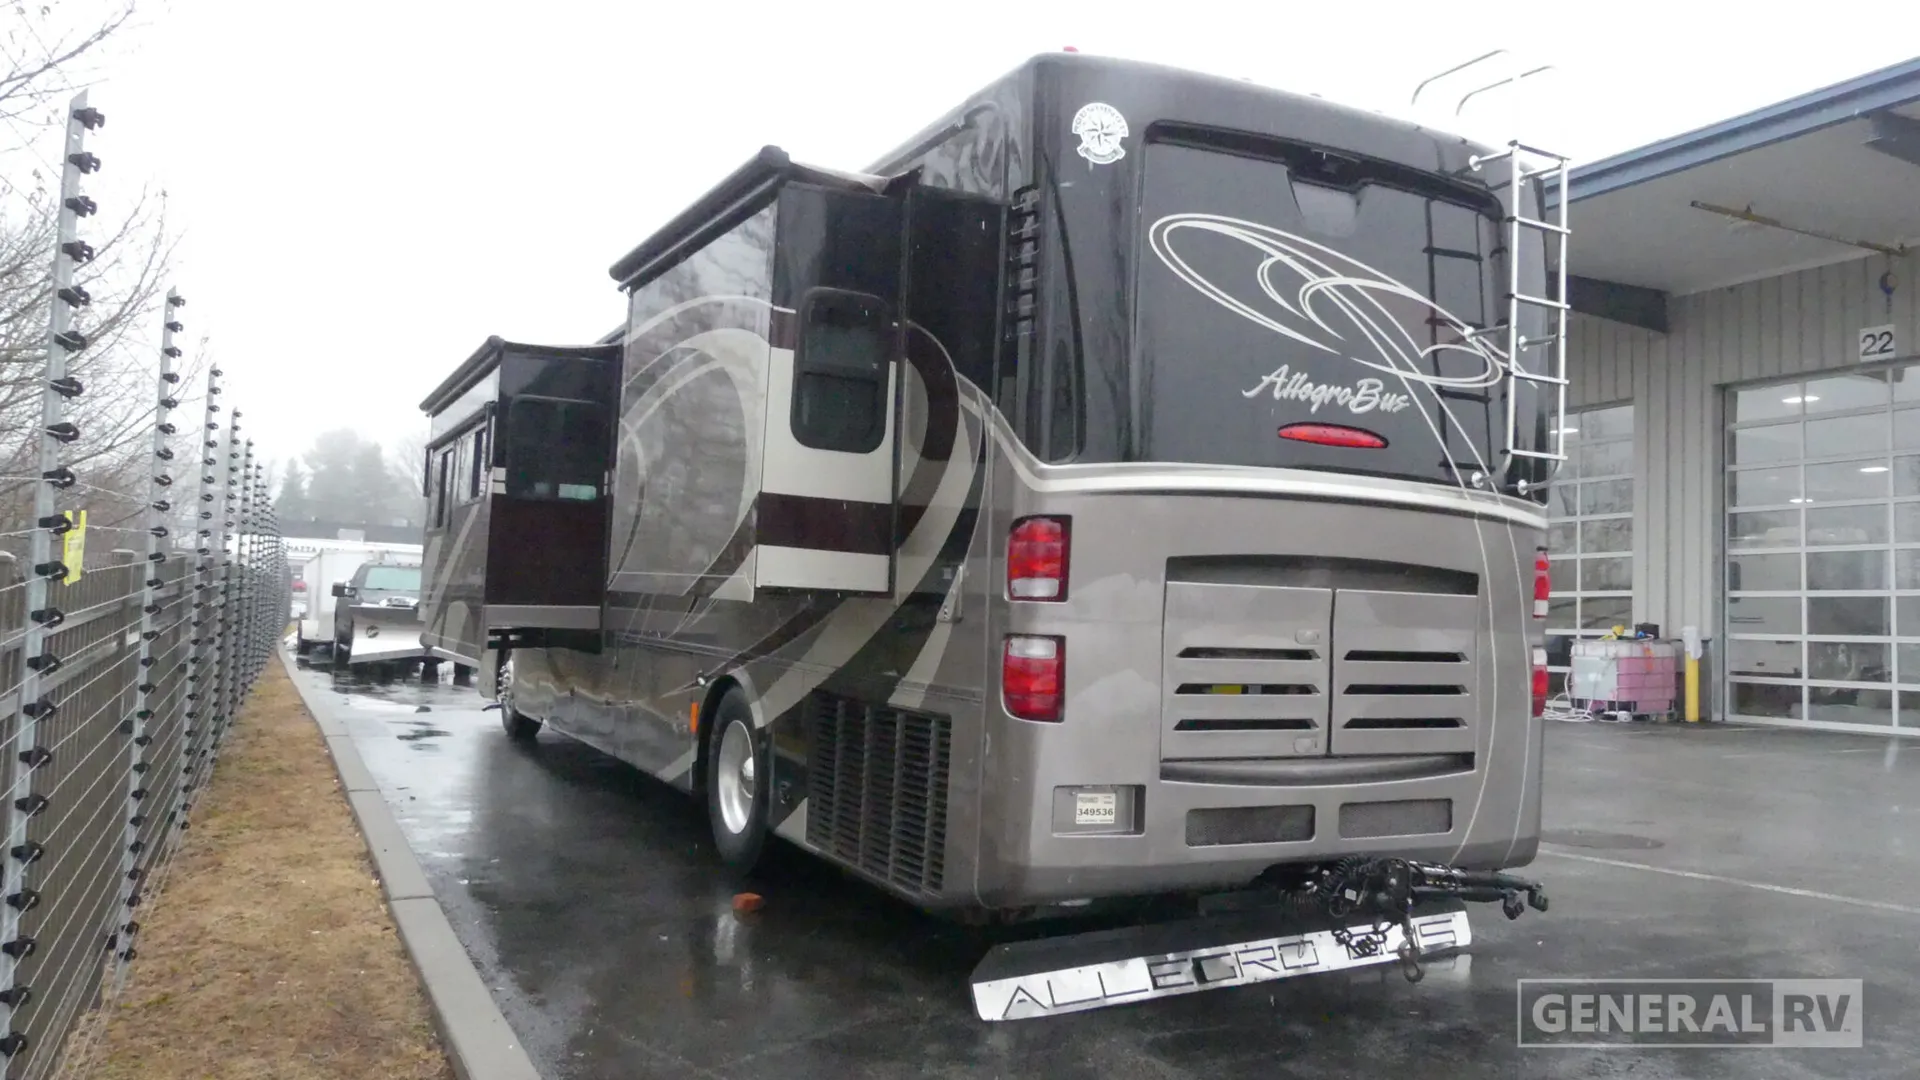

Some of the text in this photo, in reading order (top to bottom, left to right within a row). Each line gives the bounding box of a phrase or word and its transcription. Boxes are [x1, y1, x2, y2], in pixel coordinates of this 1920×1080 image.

[1861, 331, 1894, 356] 22
[1077, 808, 1114, 816] 349536
[1002, 940, 1319, 1019] ALLEGRO
